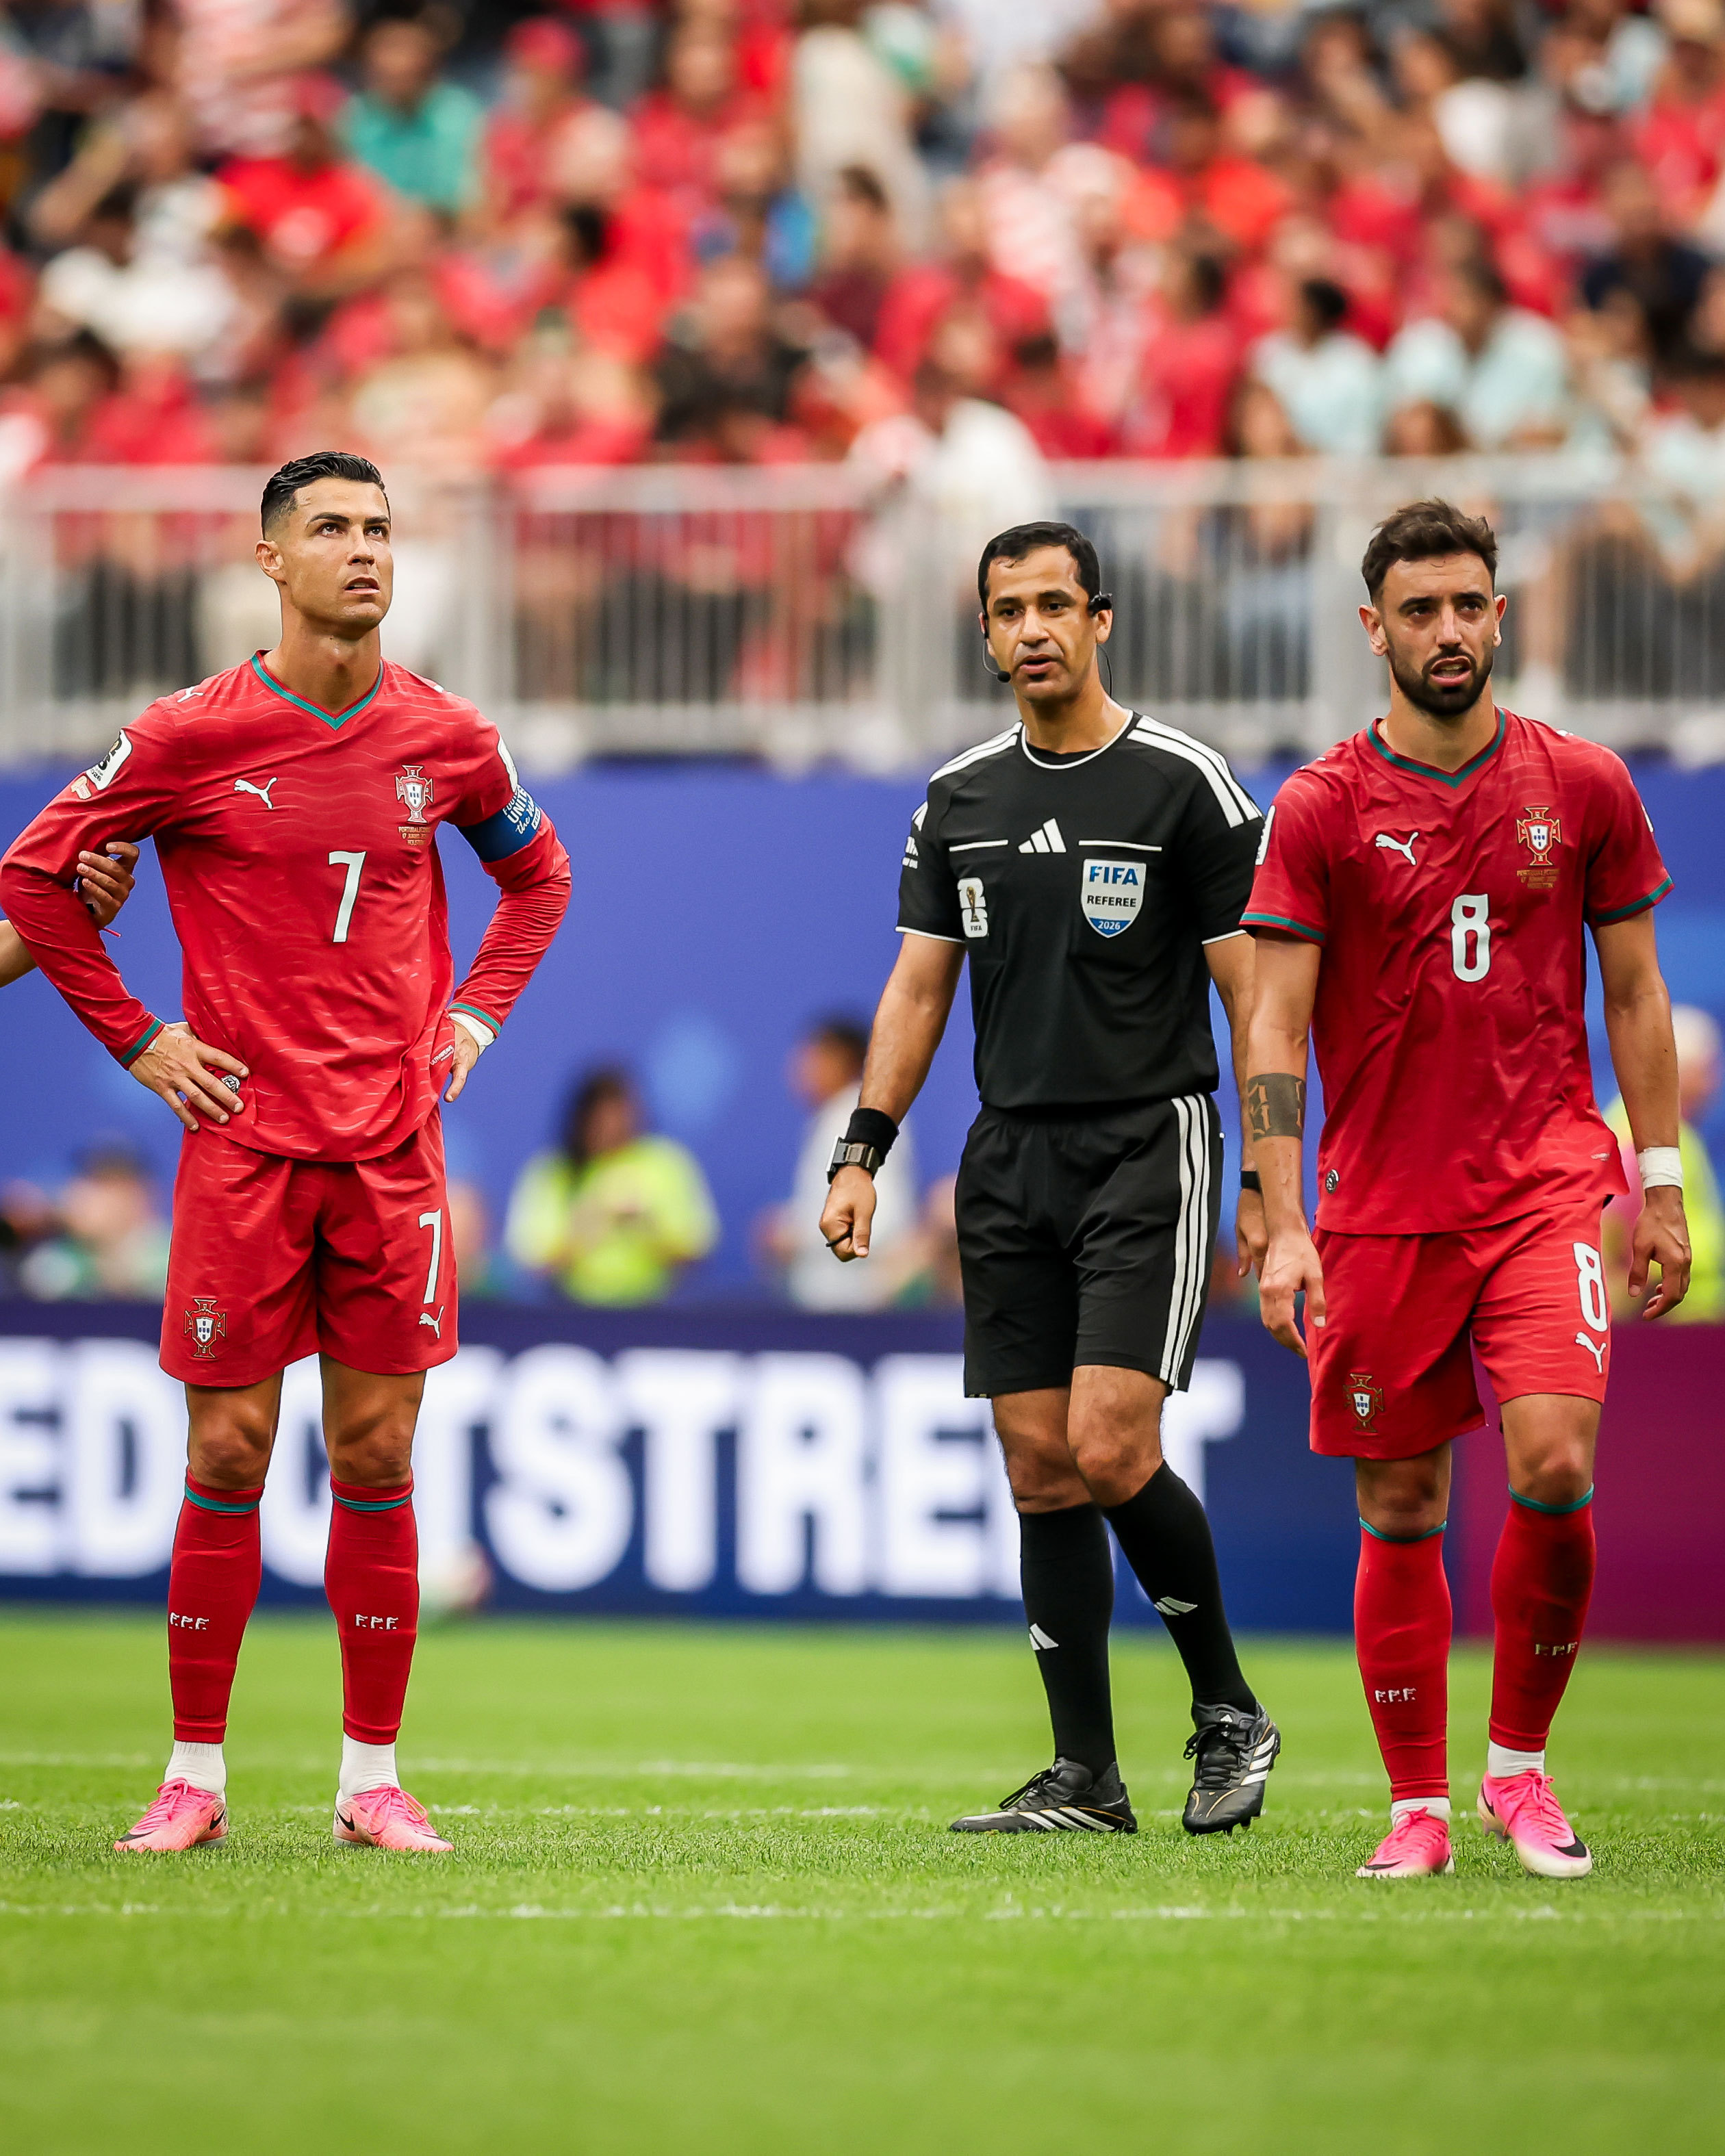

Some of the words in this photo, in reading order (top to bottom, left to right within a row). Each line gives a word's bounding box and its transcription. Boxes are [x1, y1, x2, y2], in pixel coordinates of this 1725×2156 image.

[329, 851, 366, 942] 7
[1086, 895, 1137, 908] REFEREE
[1089, 866, 1138, 886] FIFA
[1098, 921, 1121, 930] 2026
[1451, 893, 1491, 982] 8
[418, 1207, 442, 1305] 7
[1572, 1241, 1608, 1332] 8
